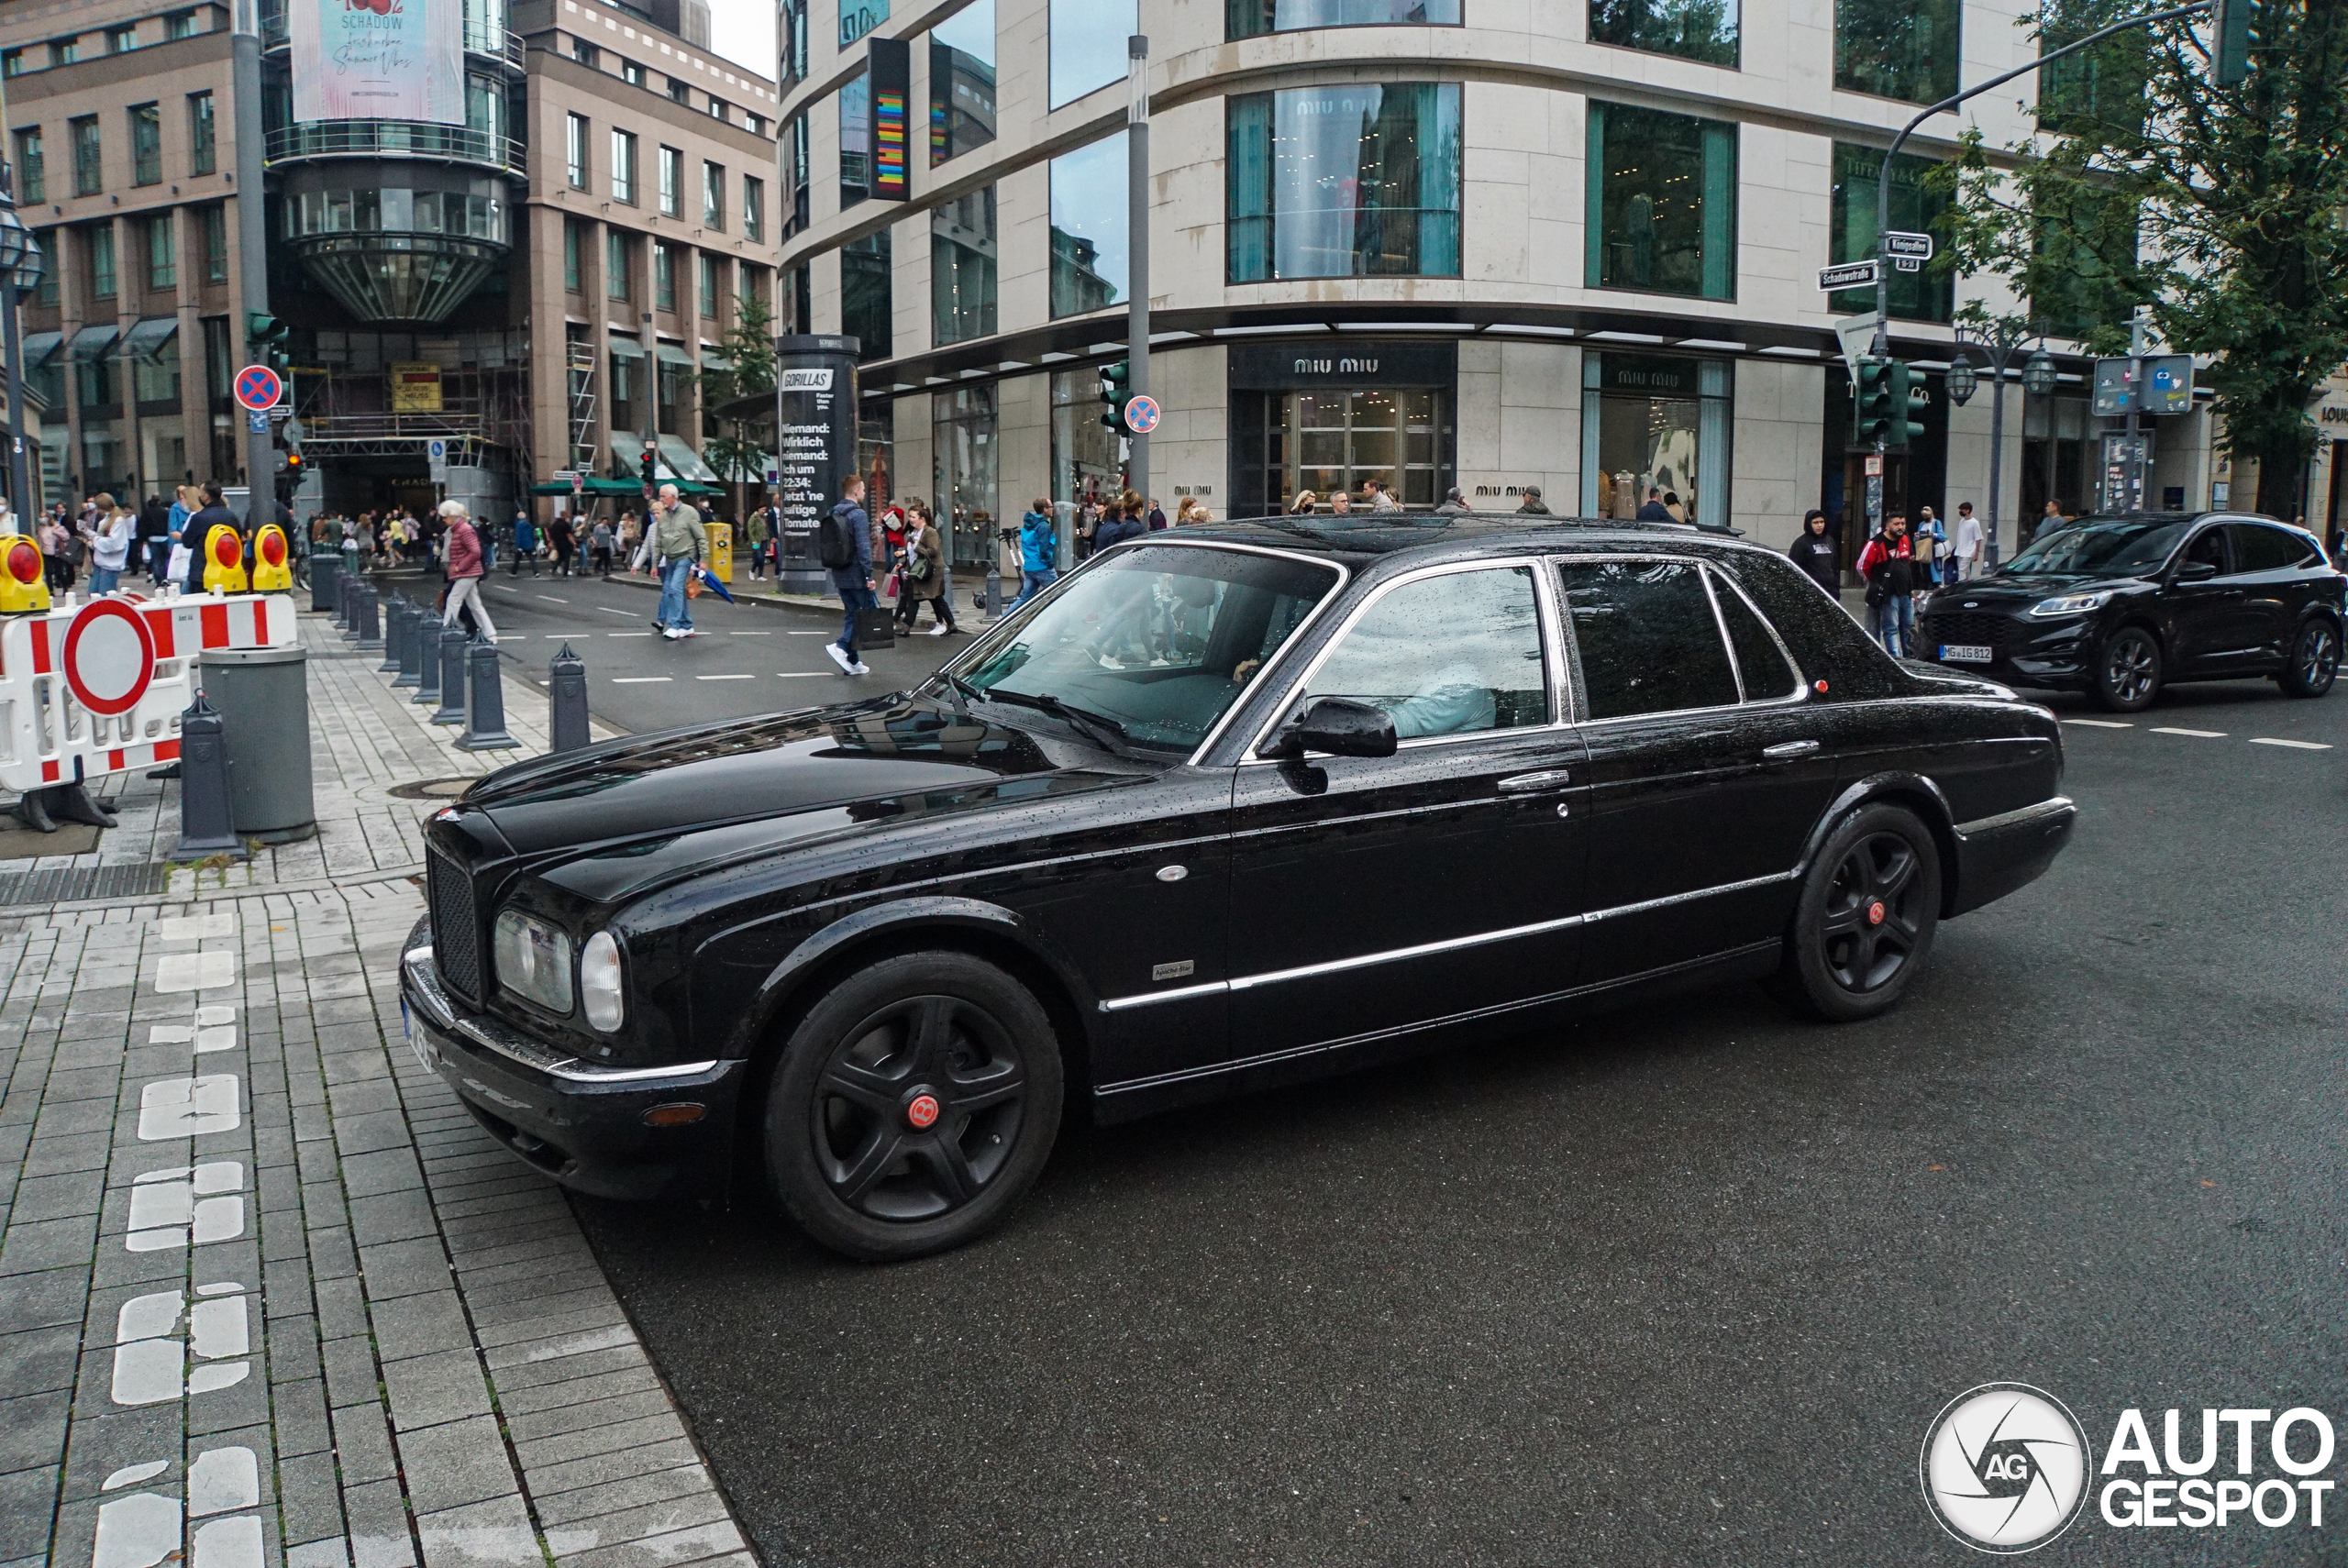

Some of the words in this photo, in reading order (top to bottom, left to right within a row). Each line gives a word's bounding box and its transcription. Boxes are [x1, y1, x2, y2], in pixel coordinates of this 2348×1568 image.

[341, 16, 403, 29] SCHADOW
[1845, 156, 1896, 182] TIFFAY
[1891, 238, 1926, 253] Königsallee
[1822, 268, 1869, 284] Schadowstraße
[1294, 359, 1332, 373] MIU
[1339, 358, 1379, 373] MIU
[784, 372, 827, 387] GORILLAS
[1618, 370, 1645, 385] MIU
[1652, 371, 1678, 388] MIU
[782, 423, 830, 434] Niemand:
[783, 436, 824, 447] Wirklich
[783, 450, 828, 460] niemand:
[783, 464, 795, 474] Ich
[797, 465, 815, 474] um
[783, 477, 812, 488] 22:34:
[784, 491, 805, 501] Jetzt
[1175, 485, 1191, 496] MIU
[1194, 485, 1212, 496] MIU
[1476, 485, 1501, 496] MIU
[784, 503, 817, 517] saftige
[1944, 646, 1956, 657] MG
[1962, 647, 1973, 657] IG
[1974, 647, 1990, 659] 812
